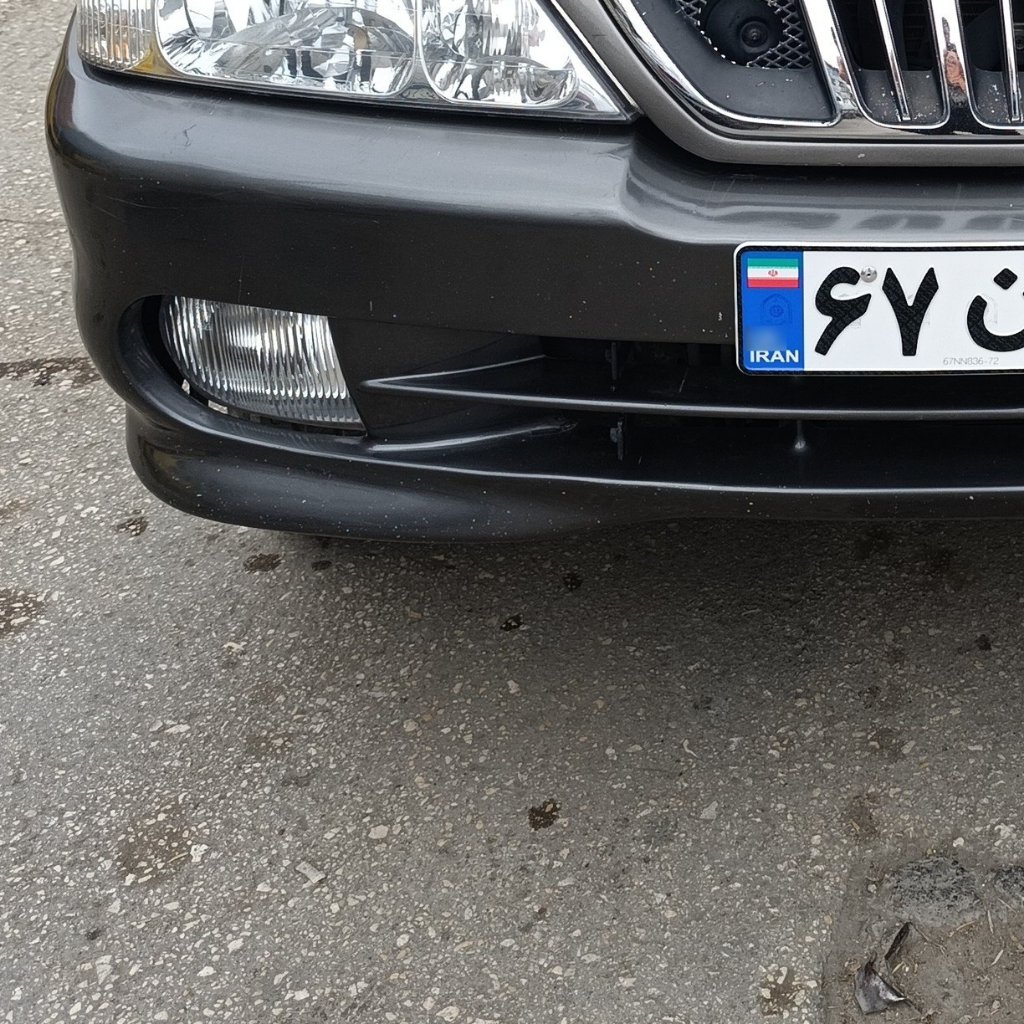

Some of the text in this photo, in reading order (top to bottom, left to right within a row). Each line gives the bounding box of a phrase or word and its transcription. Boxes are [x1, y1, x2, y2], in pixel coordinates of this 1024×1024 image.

[814, 266, 939, 356] ۶۷
[750, 349, 799, 363] IRAN
[943, 356, 1000, 366] 67NN836-72
